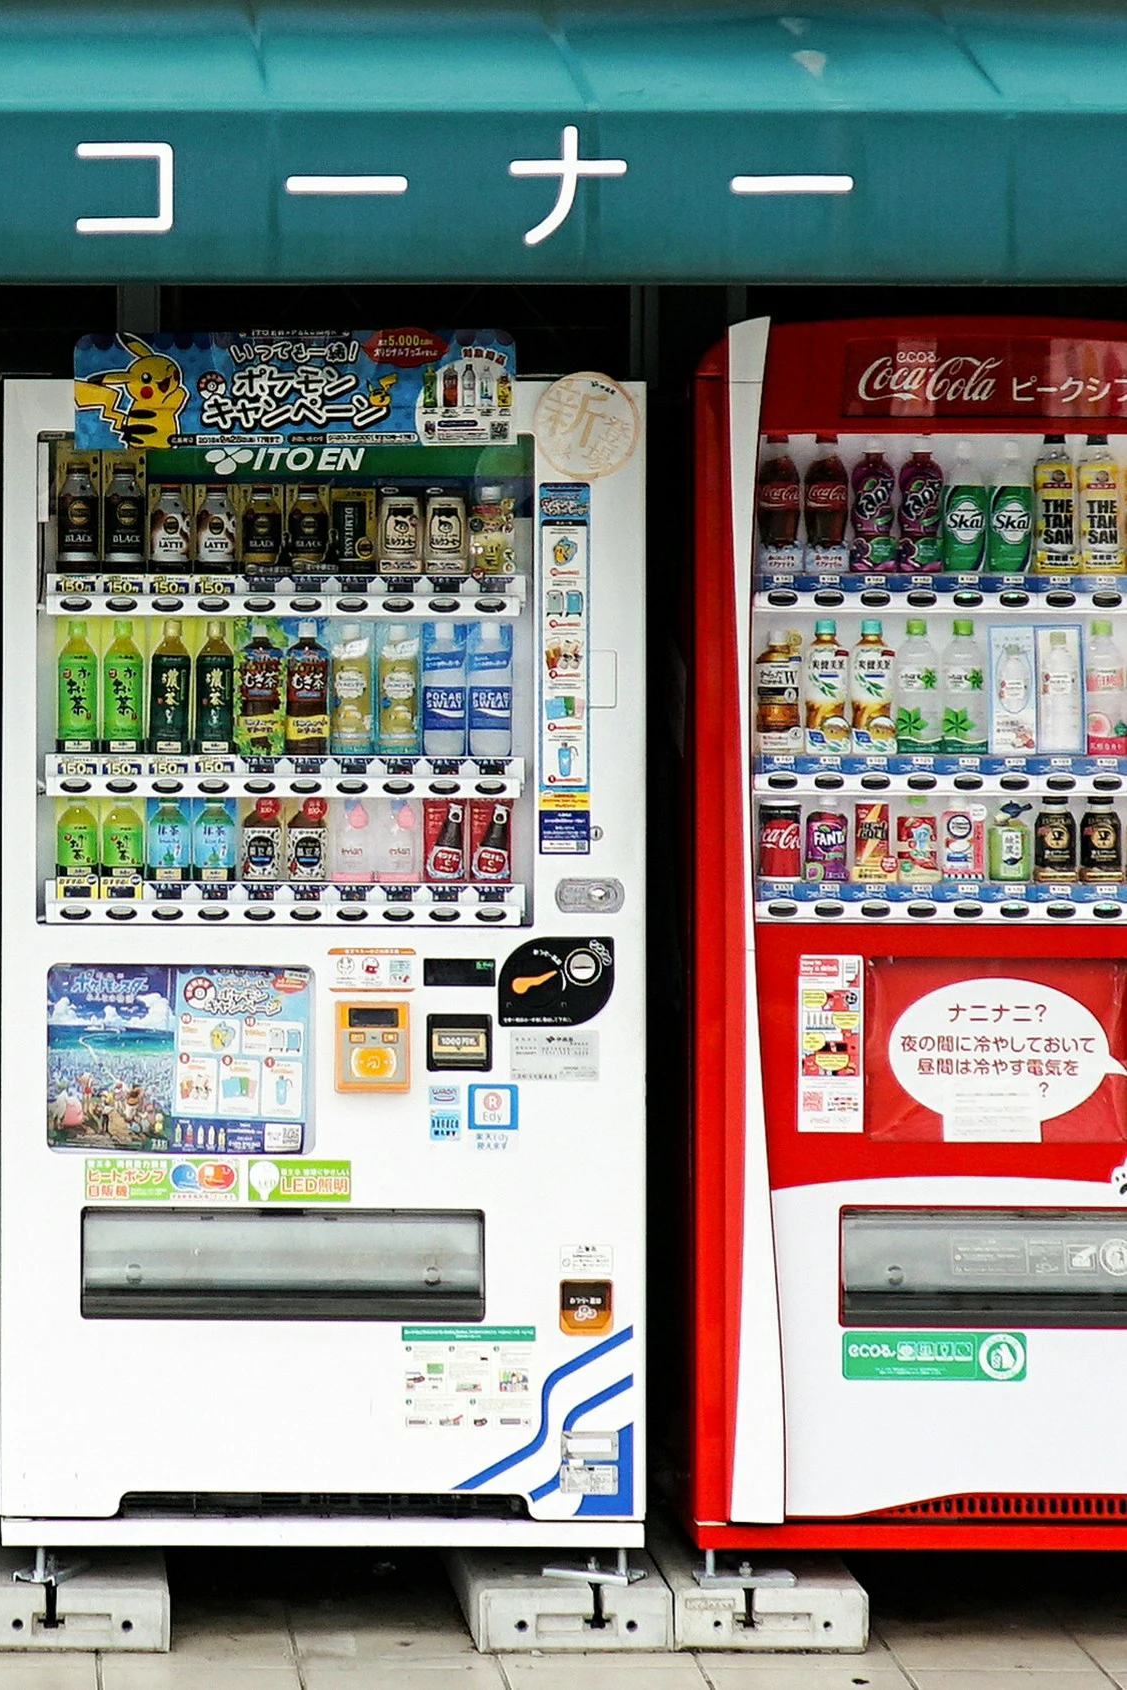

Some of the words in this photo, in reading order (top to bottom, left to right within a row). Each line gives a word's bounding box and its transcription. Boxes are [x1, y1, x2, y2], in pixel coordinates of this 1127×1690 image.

[232, 364, 358, 397] ポケモン
[858, 356, 1003, 401] Coca-Cola
[202, 394, 388, 431] キャンペーン
[252, 447, 314, 472] ITO
[317, 447, 365, 472] EN
[1043, 499, 1073, 513] THE
[1087, 500, 1118, 514] THE
[1043, 514, 1073, 529] TAN
[1087, 515, 1117, 529] TAN
[64, 534, 93, 543] BLACK
[113, 534, 141, 543] BLACK
[1043, 530, 1073, 544] SAN
[1087, 530, 1118, 544] SAN
[158, 541, 183, 549] LATTE
[204, 541, 229, 549] LATTE
[243, 671, 277, 689] むぎ茶
[291, 672, 324, 690] むぎ茶
[426, 701, 462, 709] SWEAT
[474, 701, 509, 709] SWEAT
[948, 1003, 1048, 1023] ナニナニ？
[900, 1034, 1097, 1054] 夜の間に冷やしておいて
[917, 1059, 1079, 1077] 昼間は冷やす電気を
[482, 1111, 503, 1123] Edy
[281, 1178, 349, 1194] LED照明
